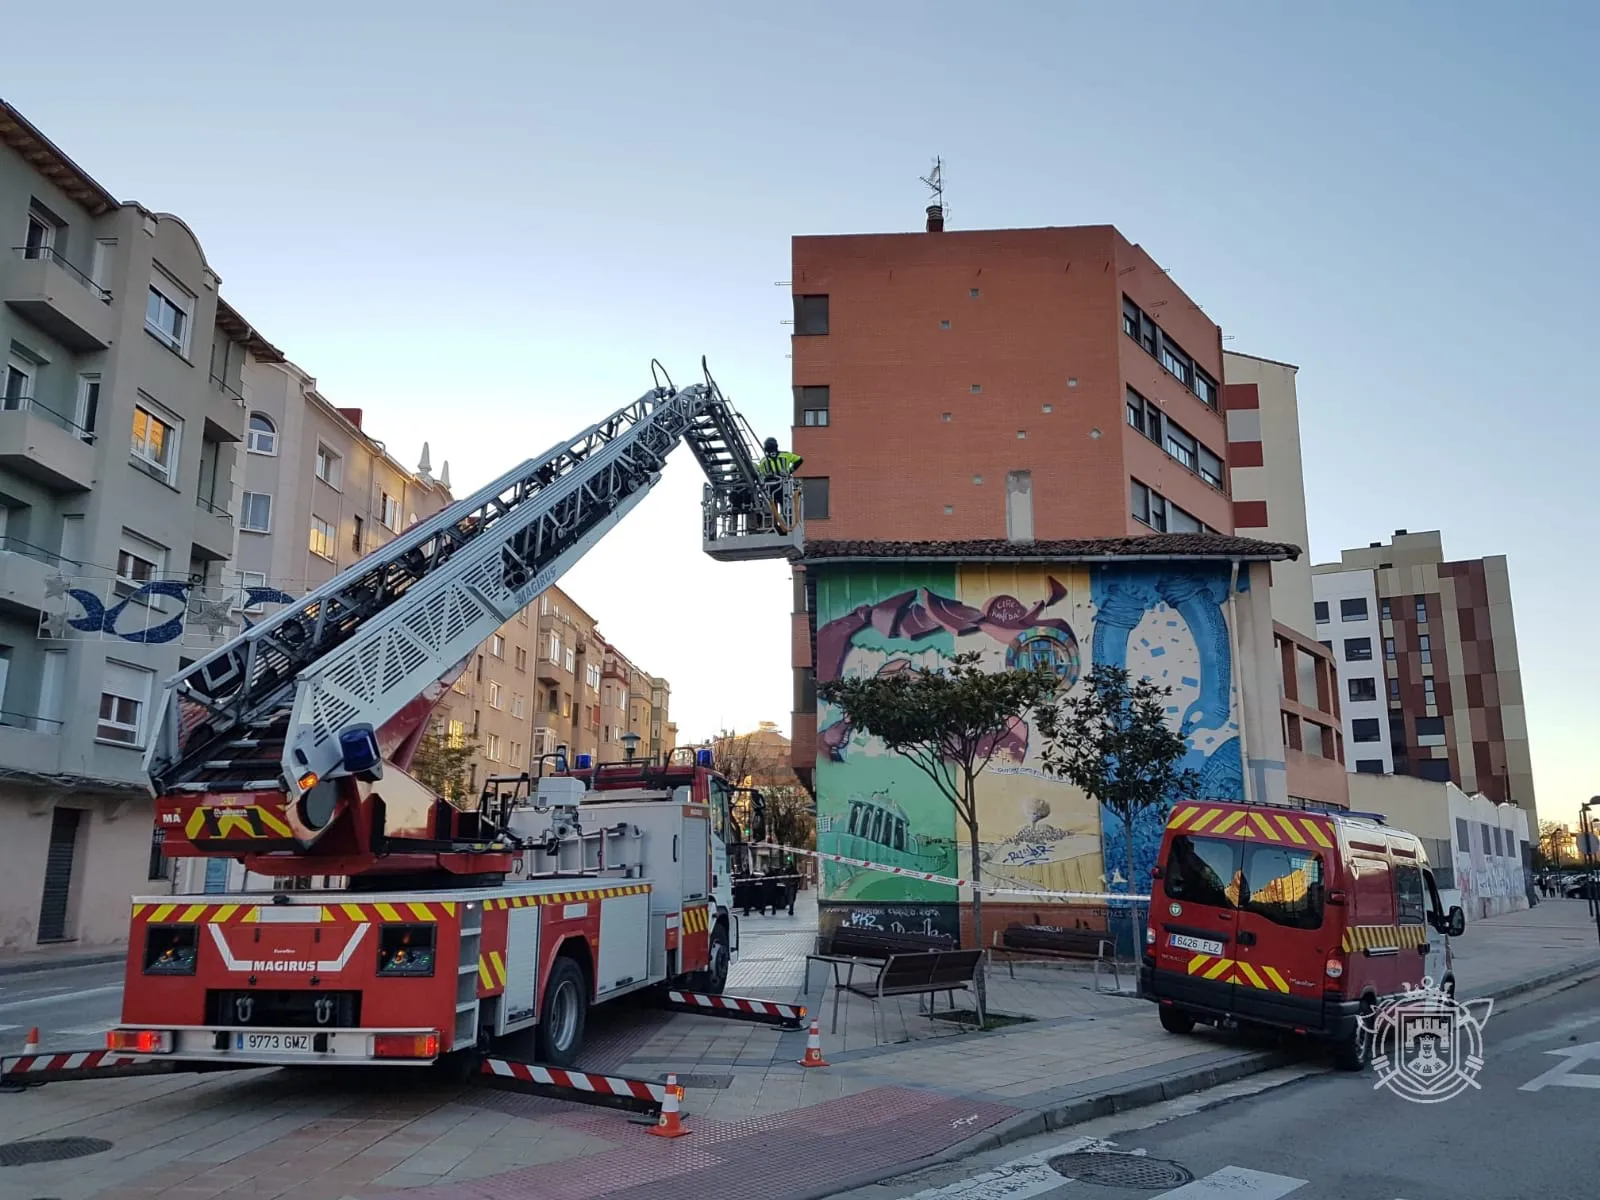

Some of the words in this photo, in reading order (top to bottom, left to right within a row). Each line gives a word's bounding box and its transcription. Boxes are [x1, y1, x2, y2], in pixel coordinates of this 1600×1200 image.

[515, 565, 557, 605] MAGIRUS
[1177, 936, 1198, 949] 6426
[1203, 940, 1220, 953] FLZ
[253, 960, 317, 972] MAGIRUS
[248, 1034, 280, 1049] 9773
[284, 1035, 308, 1049] GMZ
